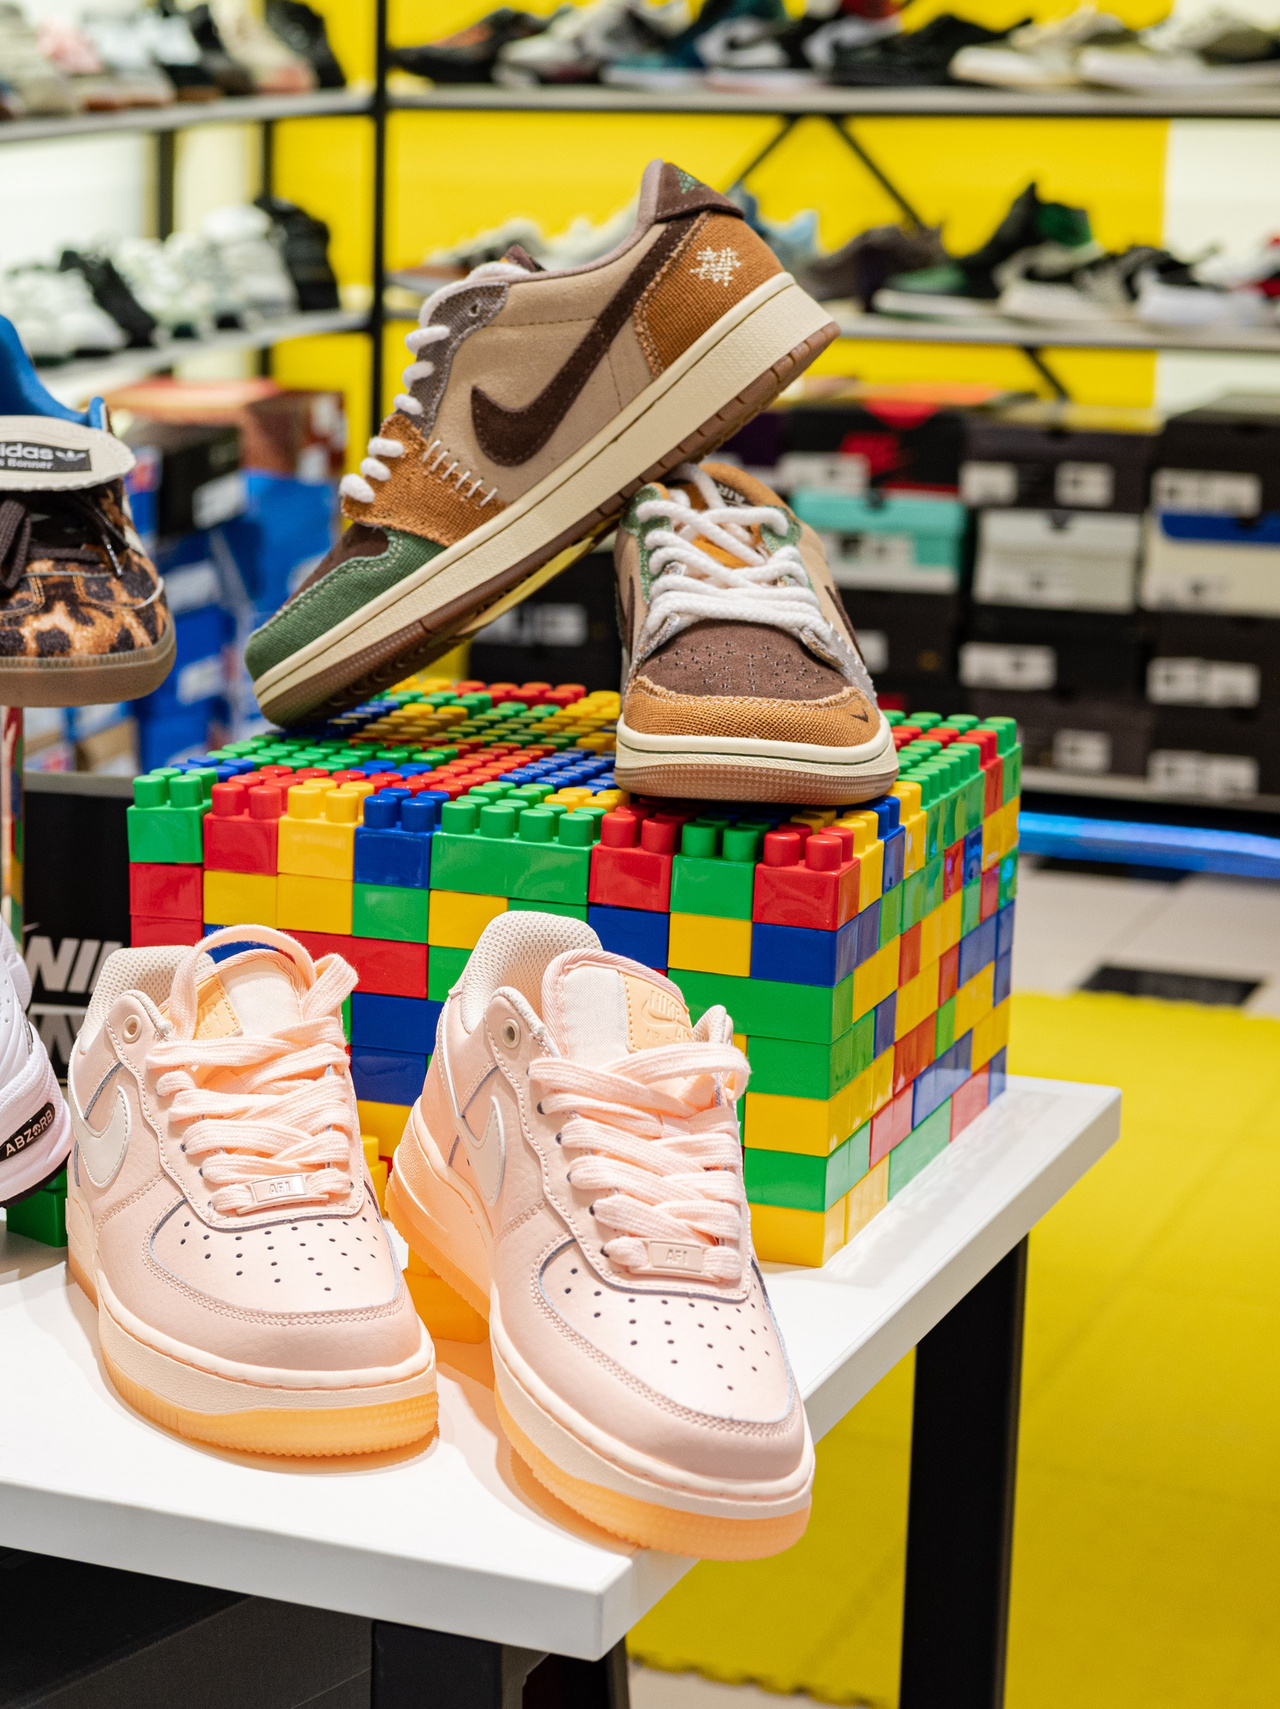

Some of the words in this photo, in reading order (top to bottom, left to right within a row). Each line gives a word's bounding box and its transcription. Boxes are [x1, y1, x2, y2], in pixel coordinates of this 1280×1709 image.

[7, 457, 54, 470] Bonner
[5, 1108, 55, 1158] ABZORB
[267, 1180, 293, 1196] AF1
[665, 1248, 689, 1267] AF1
